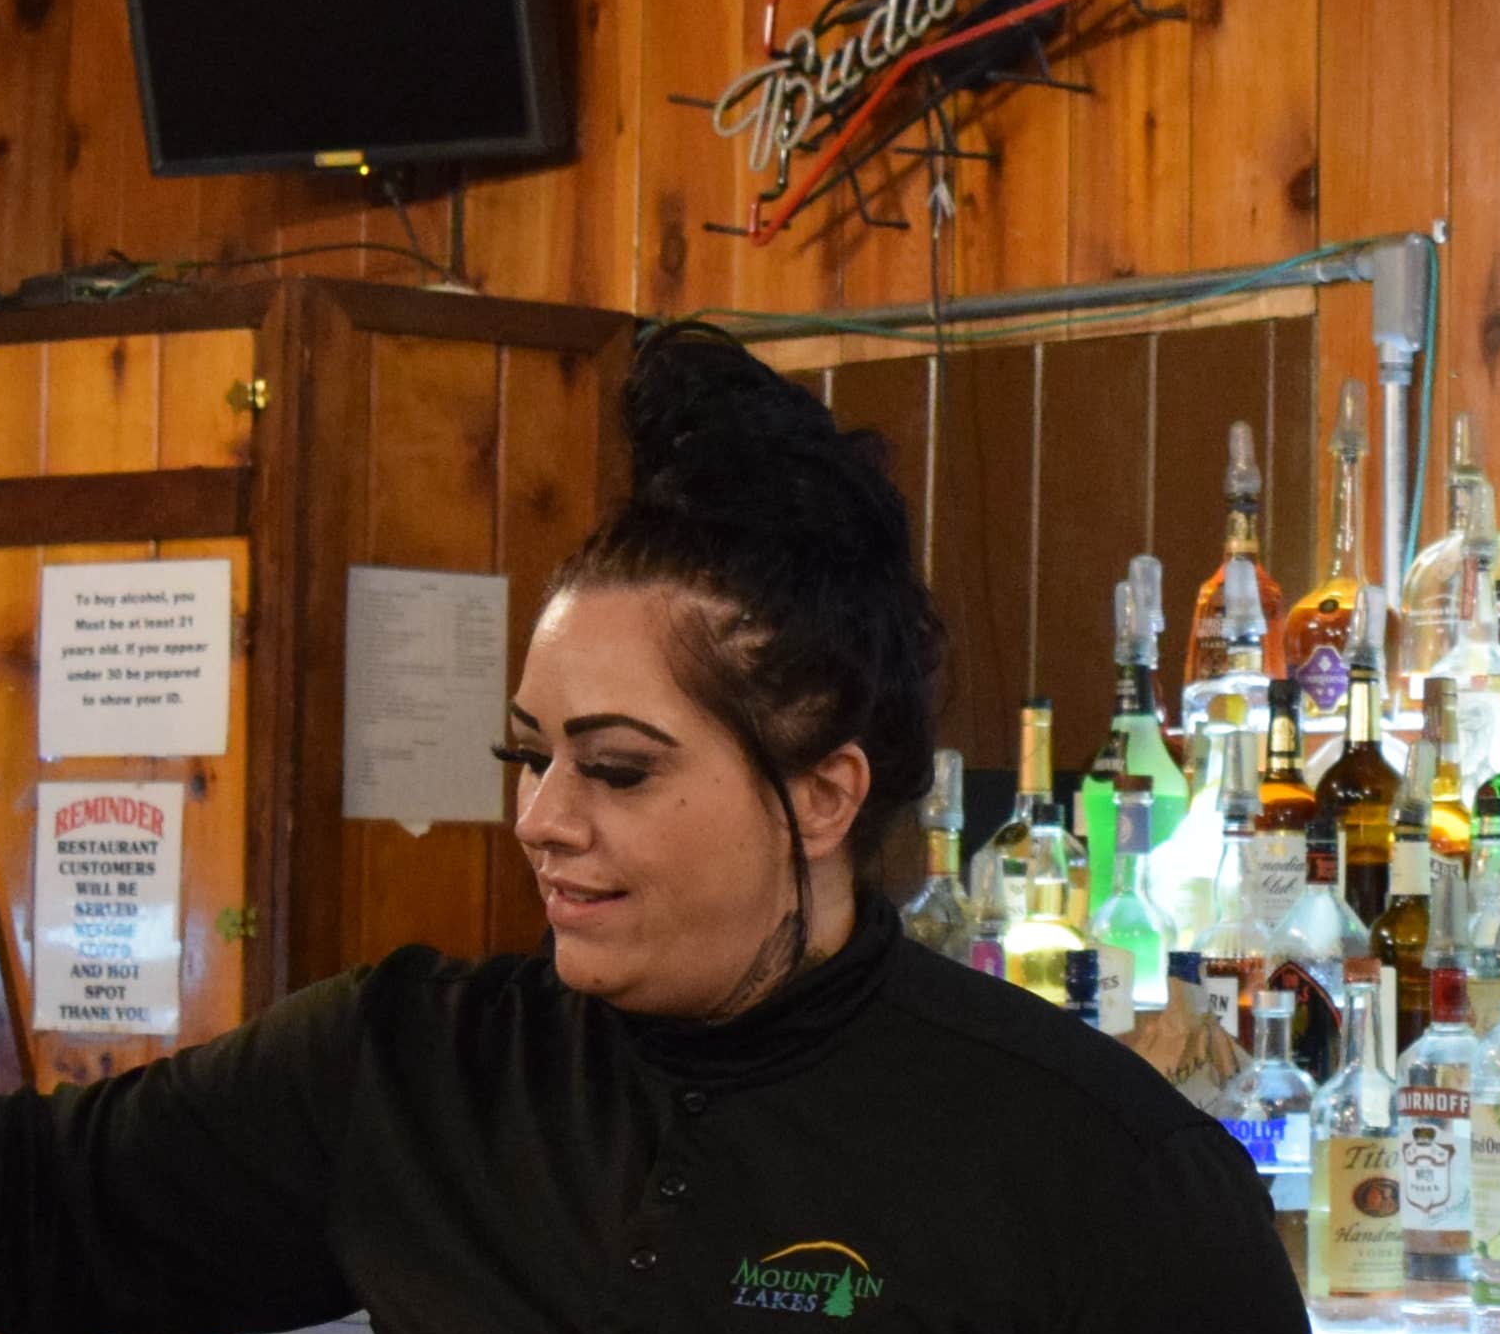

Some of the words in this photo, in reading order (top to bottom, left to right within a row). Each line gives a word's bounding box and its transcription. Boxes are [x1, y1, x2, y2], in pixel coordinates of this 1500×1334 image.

[75, 594, 91, 606] To
[95, 594, 116, 609] buy
[120, 592, 169, 605] alcohol,
[173, 592, 196, 605] you
[75, 619, 105, 631] Must
[109, 618, 125, 630] be
[128, 618, 141, 630] at
[144, 617, 175, 629] least
[179, 615, 194, 628] 21
[61, 646, 95, 660] years
[98, 644, 122, 656] old.
[125, 643, 136, 655] If
[138, 645, 160, 658] you
[163, 643, 209, 656] appear
[67, 669, 103, 682] under
[107, 668, 123, 681] 30
[125, 668, 141, 680] be
[143, 667, 202, 682] prepared
[83, 695, 96, 707] to
[100, 694, 131, 706] show
[135, 695, 164, 708] your
[53, 795, 166, 841] REMINDER
[57, 840, 160, 856] RESTAURANT
[59, 861, 157, 876] CUSTOMERS
[75, 882, 113, 897] WILL
[117, 882, 139, 897] BE
[74, 902, 139, 918] SERVED
[70, 964, 103, 979] AND
[107, 964, 141, 980] HOT
[84, 985, 127, 1000] SPOT
[58, 1006, 112, 1021] THANK
[116, 1006, 150, 1022] YOU
[732, 1287, 819, 1314] LAKES
